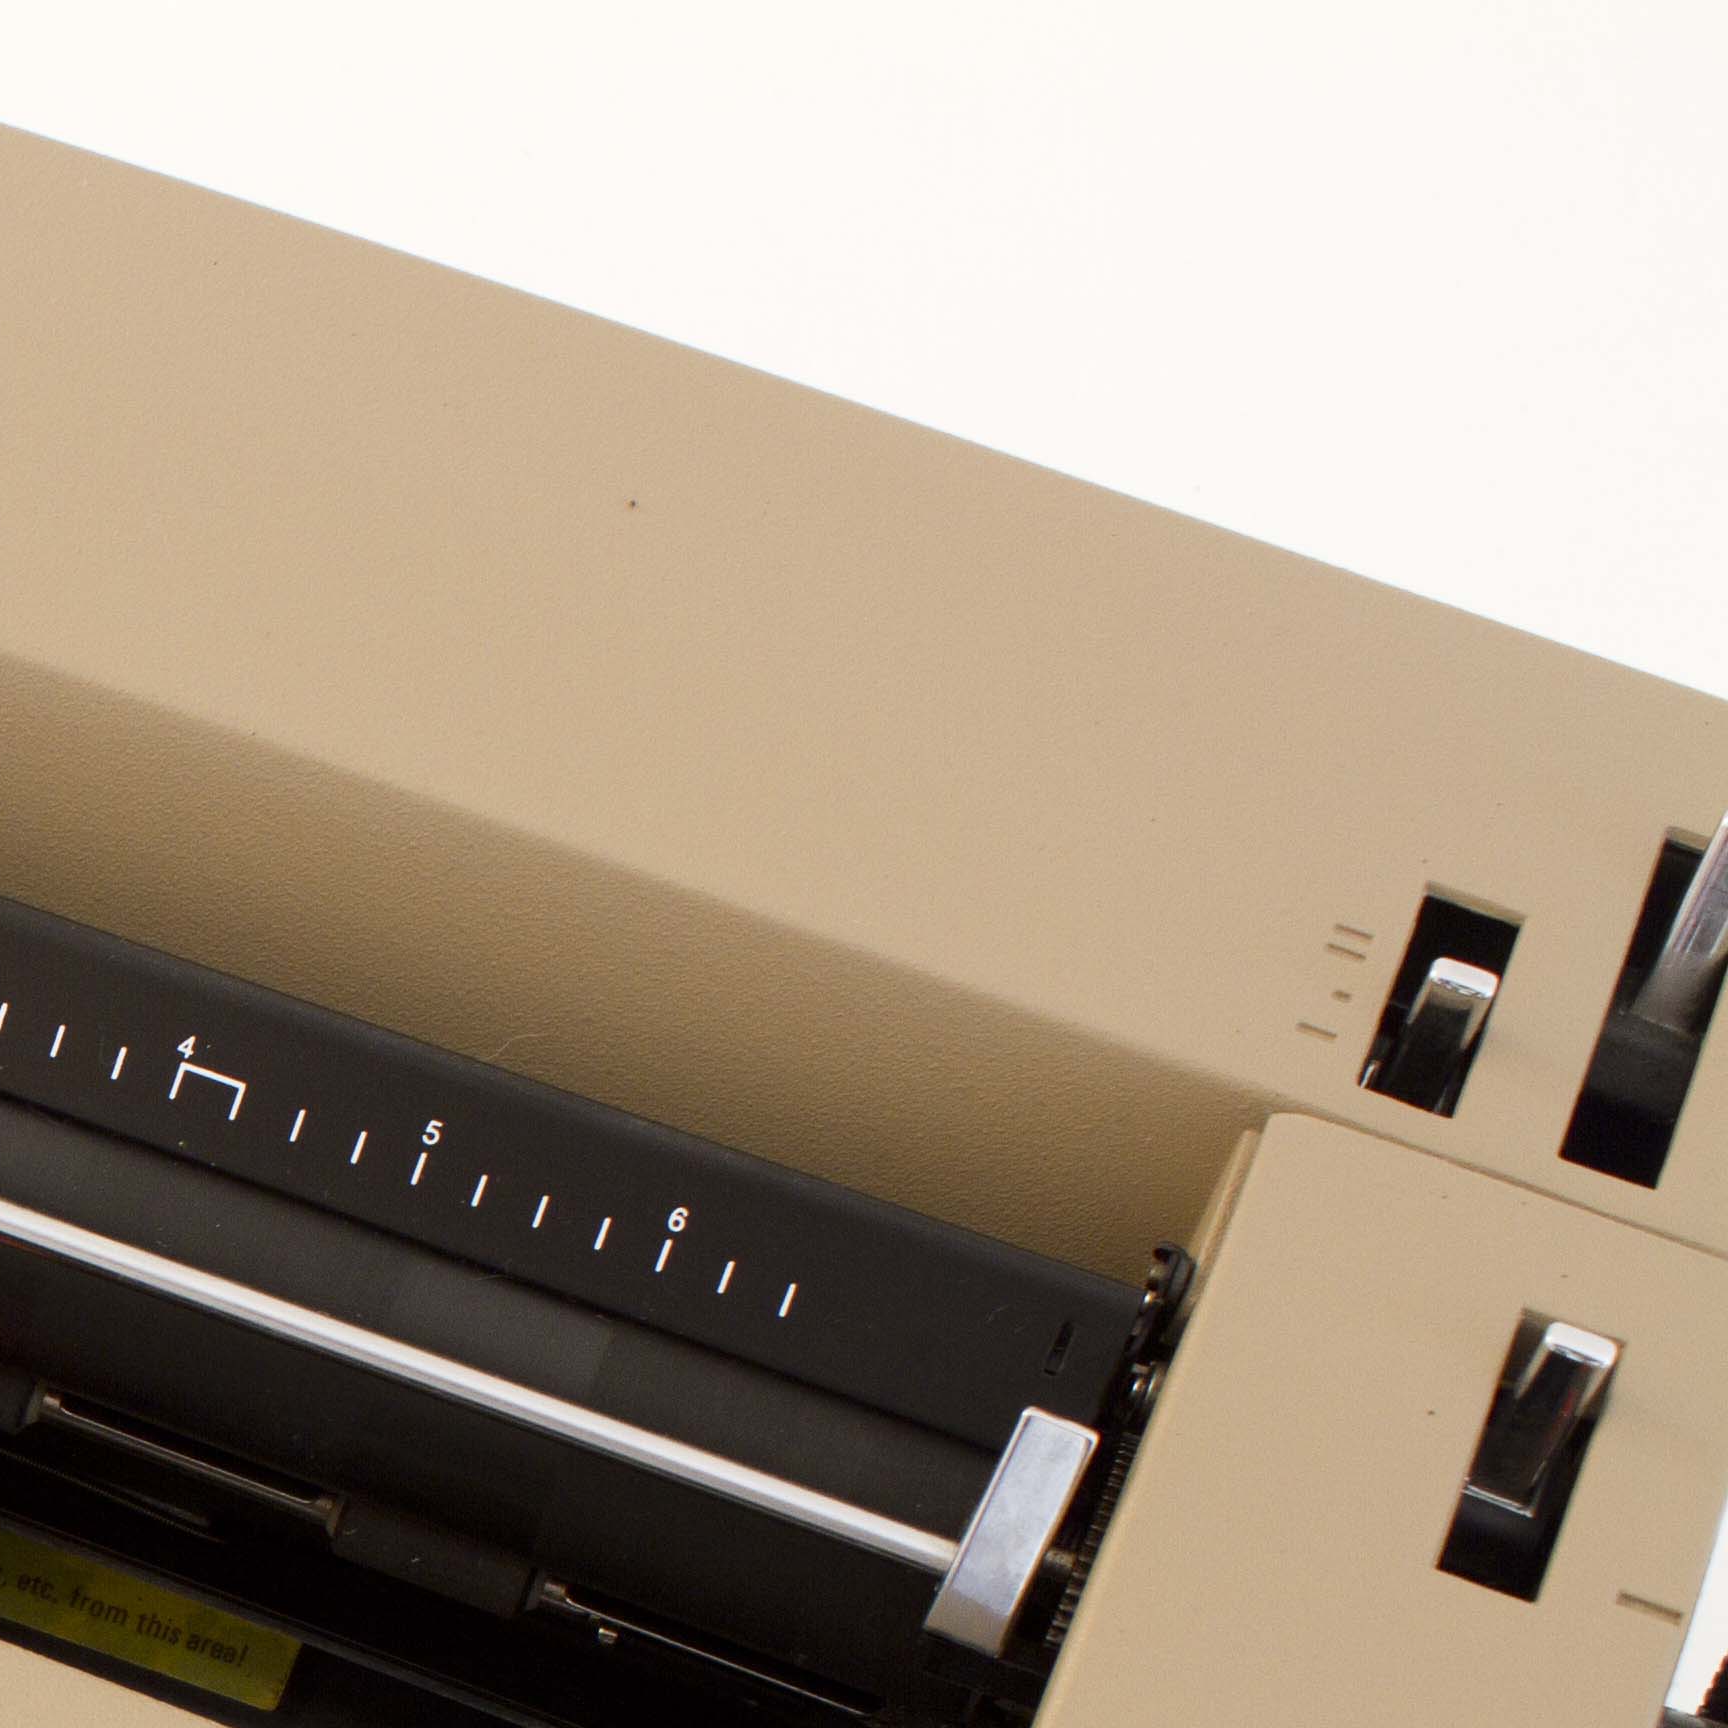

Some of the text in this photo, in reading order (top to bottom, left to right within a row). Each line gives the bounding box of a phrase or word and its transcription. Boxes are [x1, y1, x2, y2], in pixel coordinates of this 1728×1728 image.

[177, 1035, 196, 1059] 4
[422, 1119, 443, 1145] 5
[667, 1207, 689, 1233] 6
[69, 1586, 128, 1626] from
[136, 1609, 182, 1646] this
